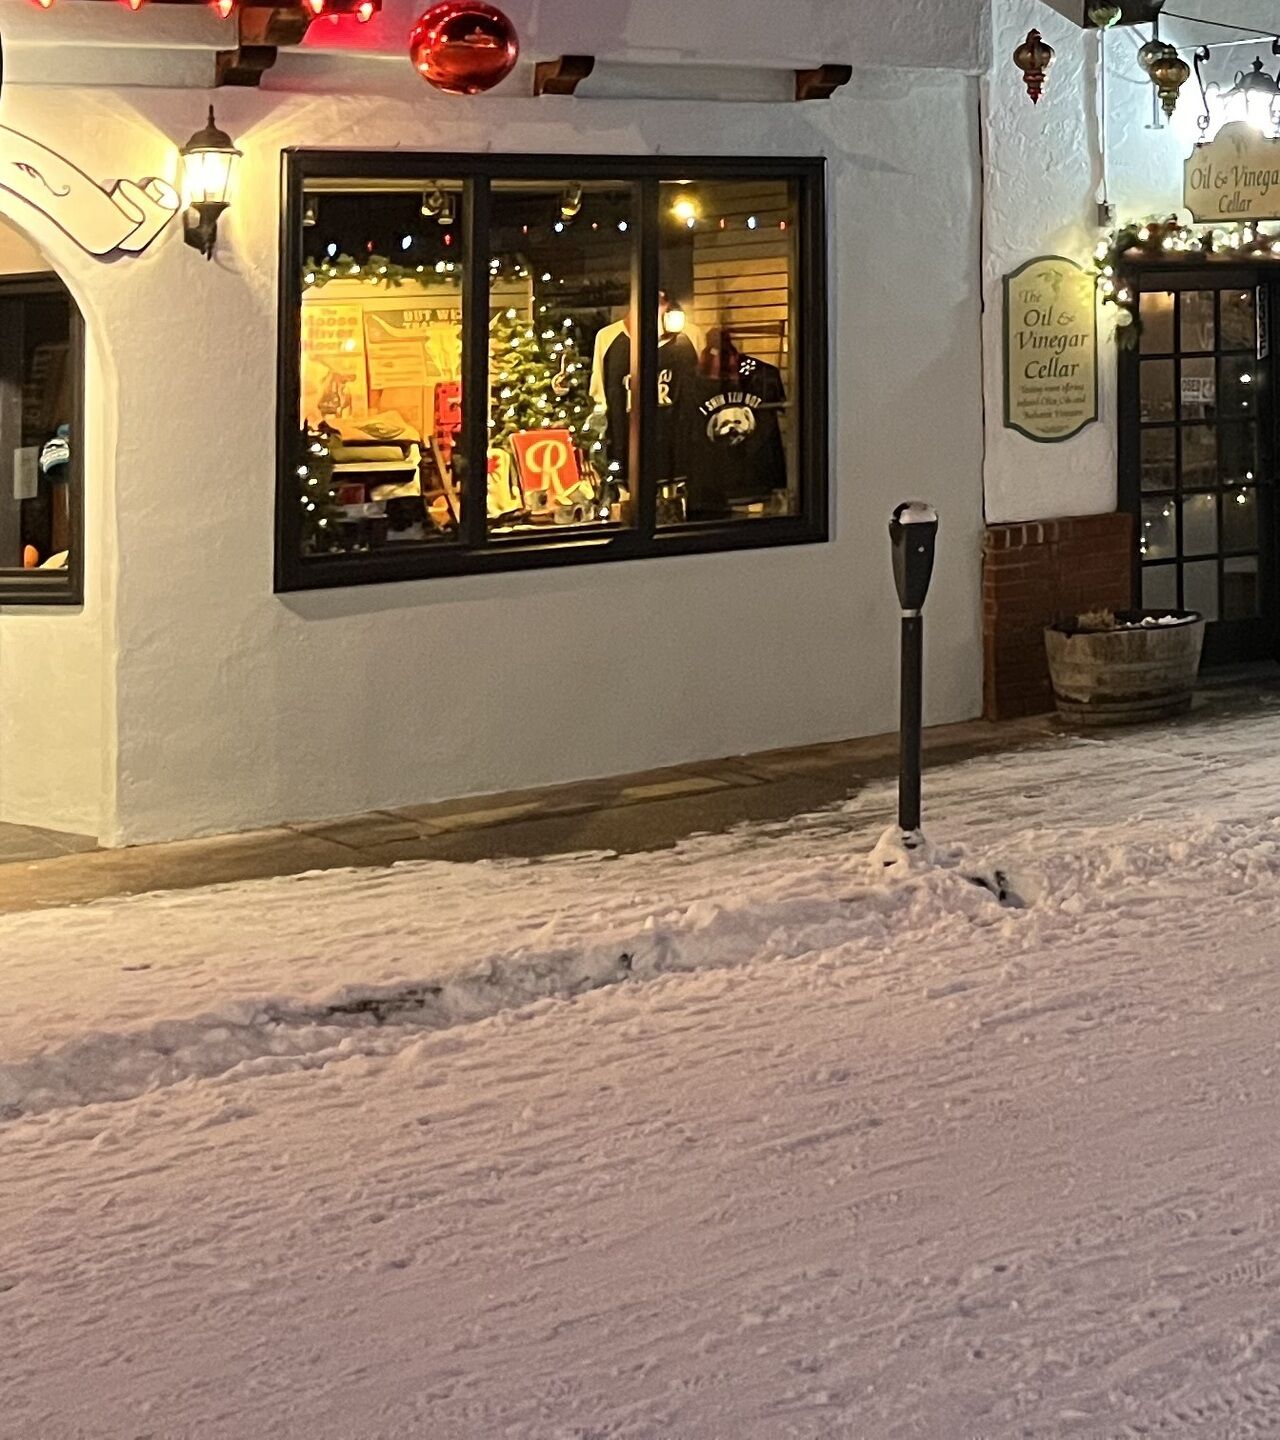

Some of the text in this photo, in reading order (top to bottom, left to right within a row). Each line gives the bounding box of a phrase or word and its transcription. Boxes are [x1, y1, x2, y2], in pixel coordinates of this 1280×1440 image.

[1190, 163, 1212, 190] Oil
[1218, 191, 1253, 213] Cellar
[1019, 290, 1042, 303] The
[1024, 306, 1076, 327] Oil &
[1014, 331, 1089, 355] Vinegar
[1024, 356, 1080, 379] Cellar
